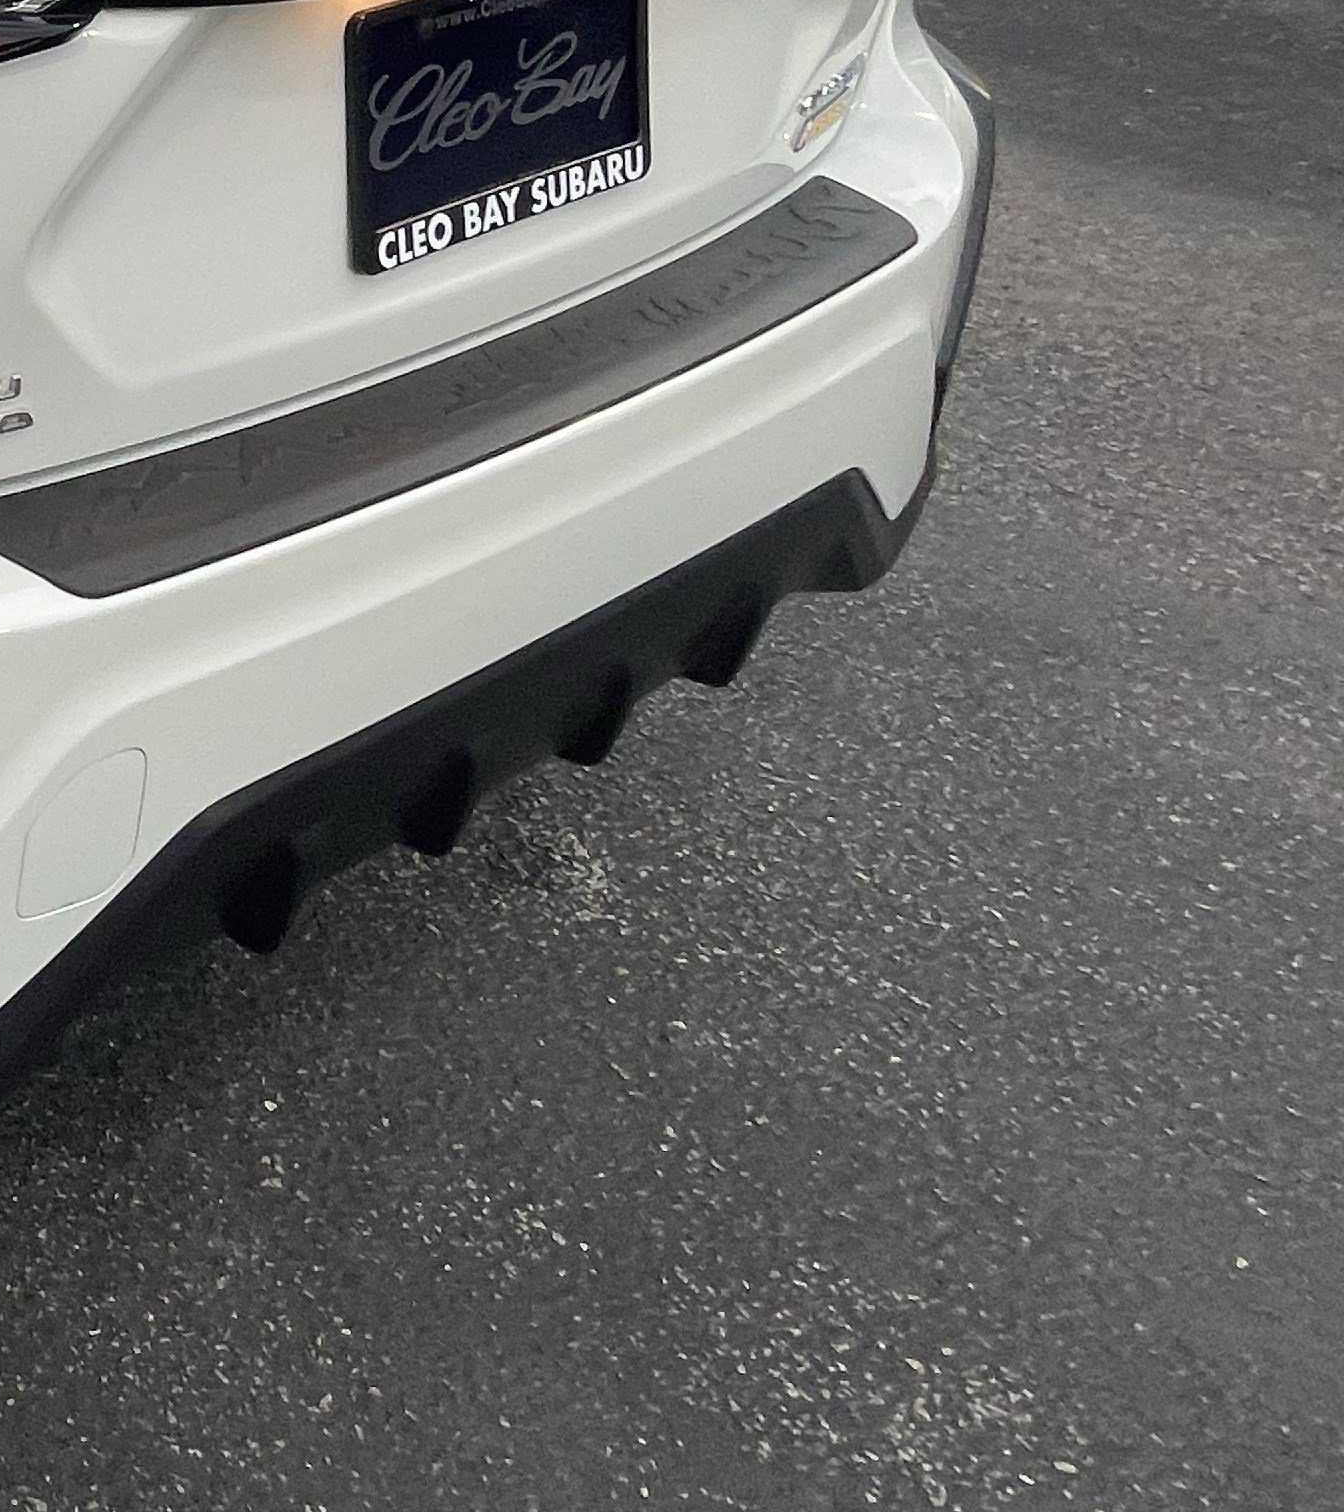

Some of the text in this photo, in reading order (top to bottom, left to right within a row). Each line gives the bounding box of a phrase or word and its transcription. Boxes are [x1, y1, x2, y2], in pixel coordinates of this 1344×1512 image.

[368, 31, 626, 171] Cleo Bay
[378, 144, 644, 269] CLEO BAY SUBARU
